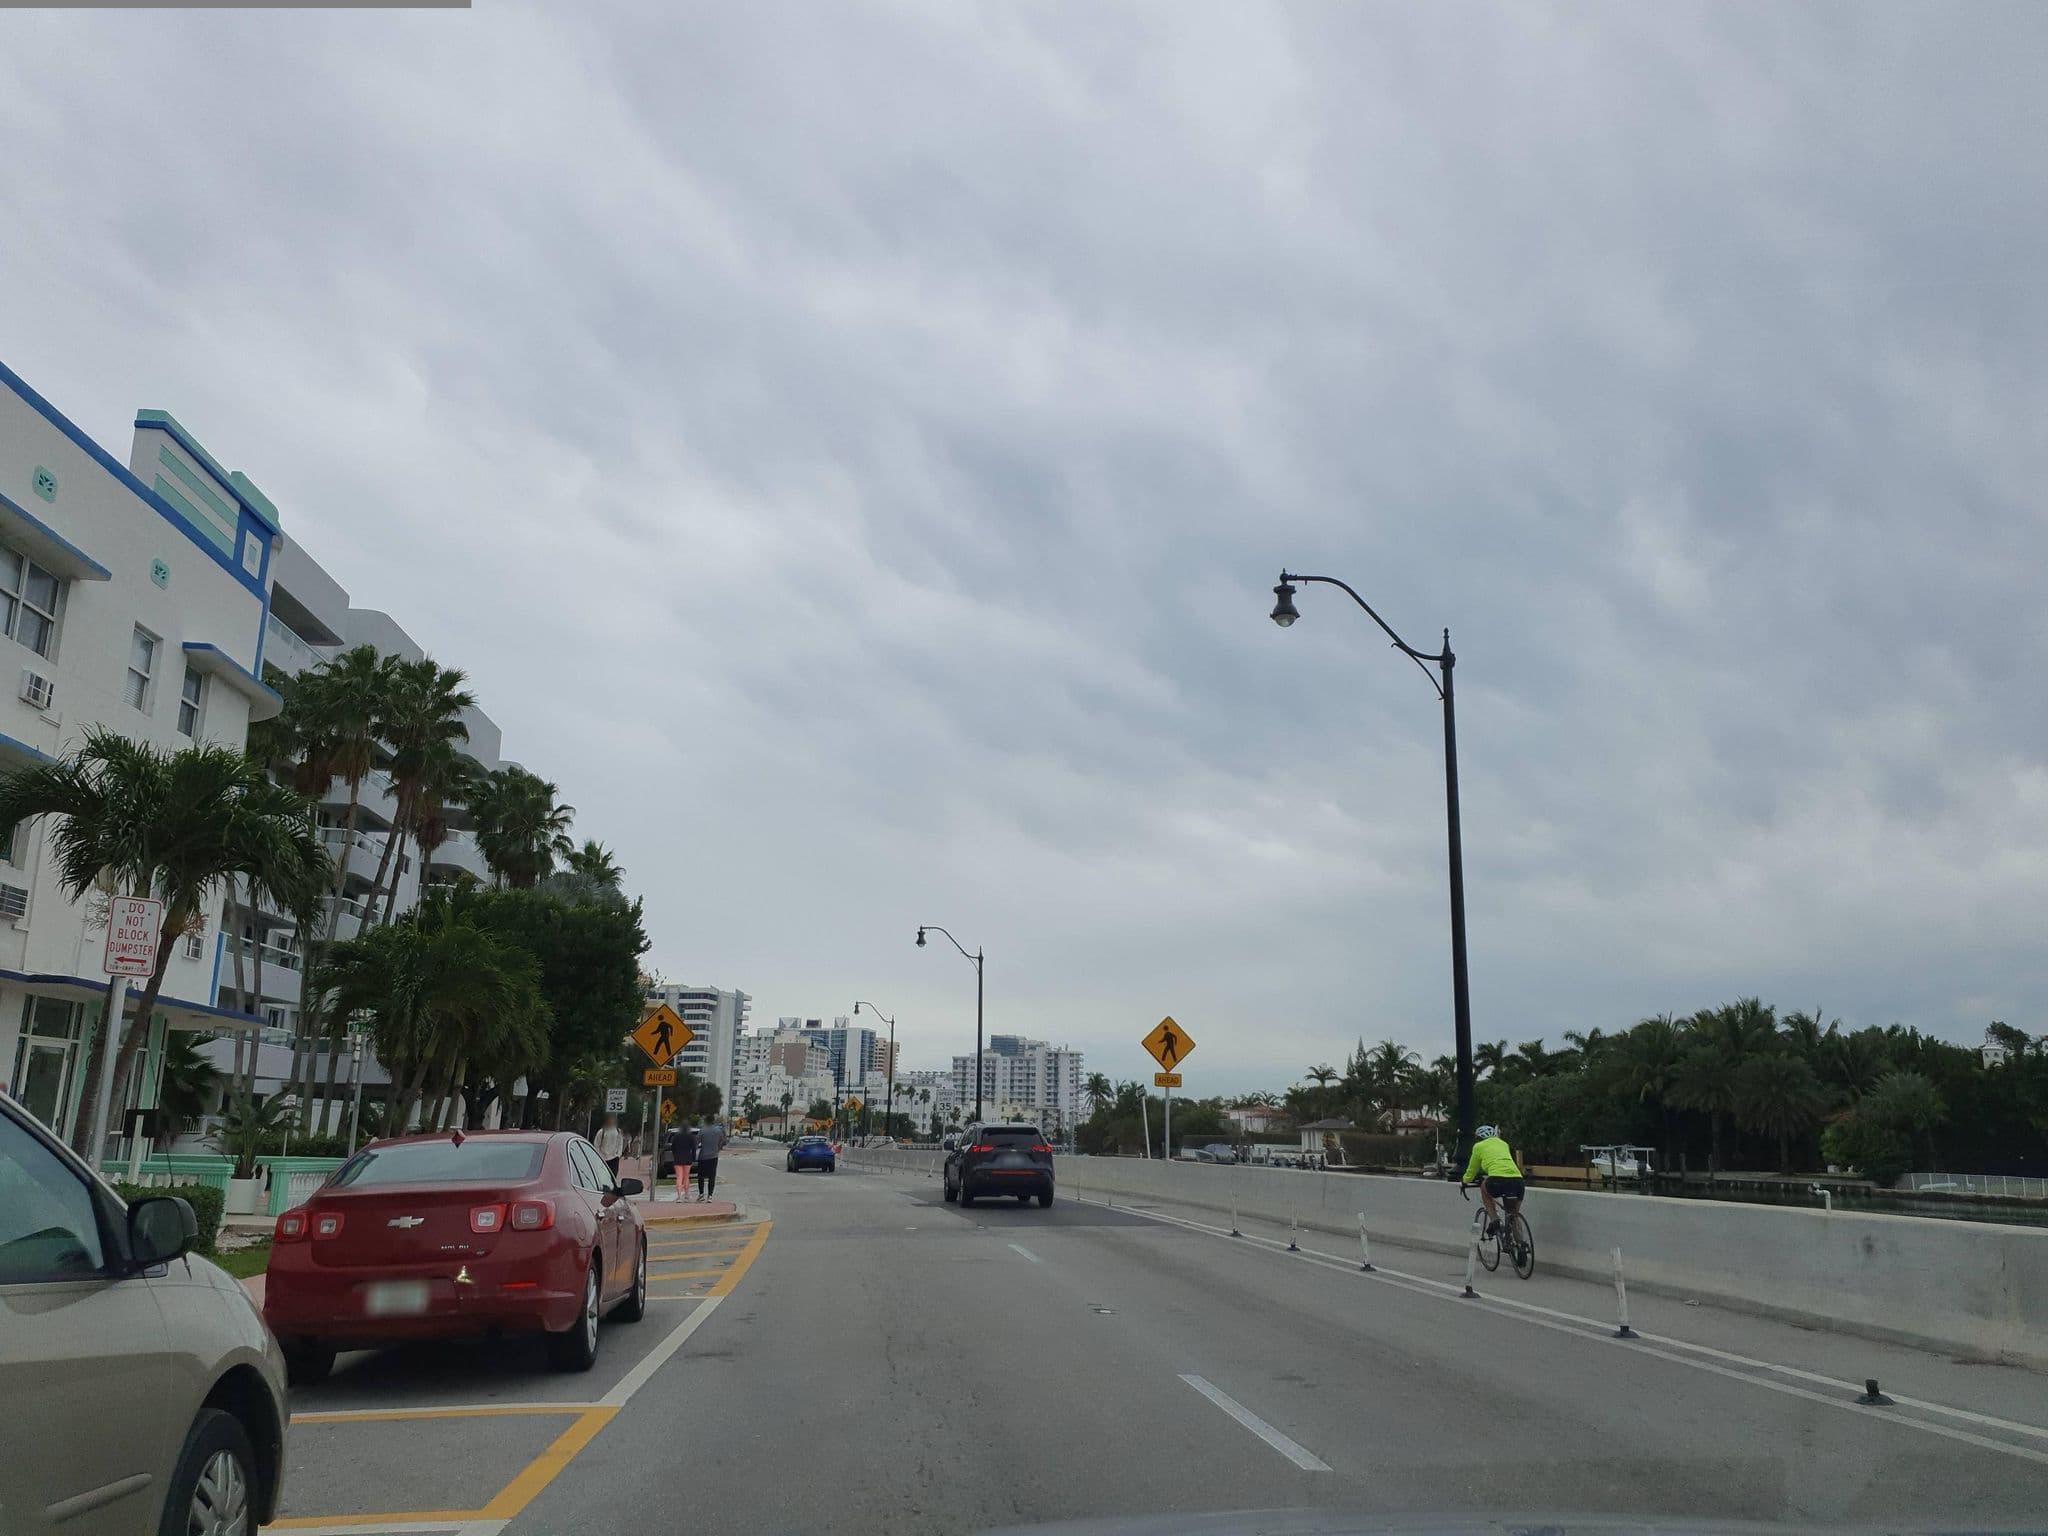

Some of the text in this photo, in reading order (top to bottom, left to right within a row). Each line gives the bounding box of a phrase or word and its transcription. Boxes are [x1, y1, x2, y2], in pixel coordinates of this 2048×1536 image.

[128, 902, 145, 914] DO
[125, 915, 145, 927] NOT
[117, 927, 149, 941] BLOCK
[109, 941, 154, 957] DUMPSTER
[647, 1073, 673, 1081] AHEAD
[1157, 1075, 1179, 1085] AHEAD
[609, 1101, 624, 1111] 35
[939, 1102, 952, 1111] 35
